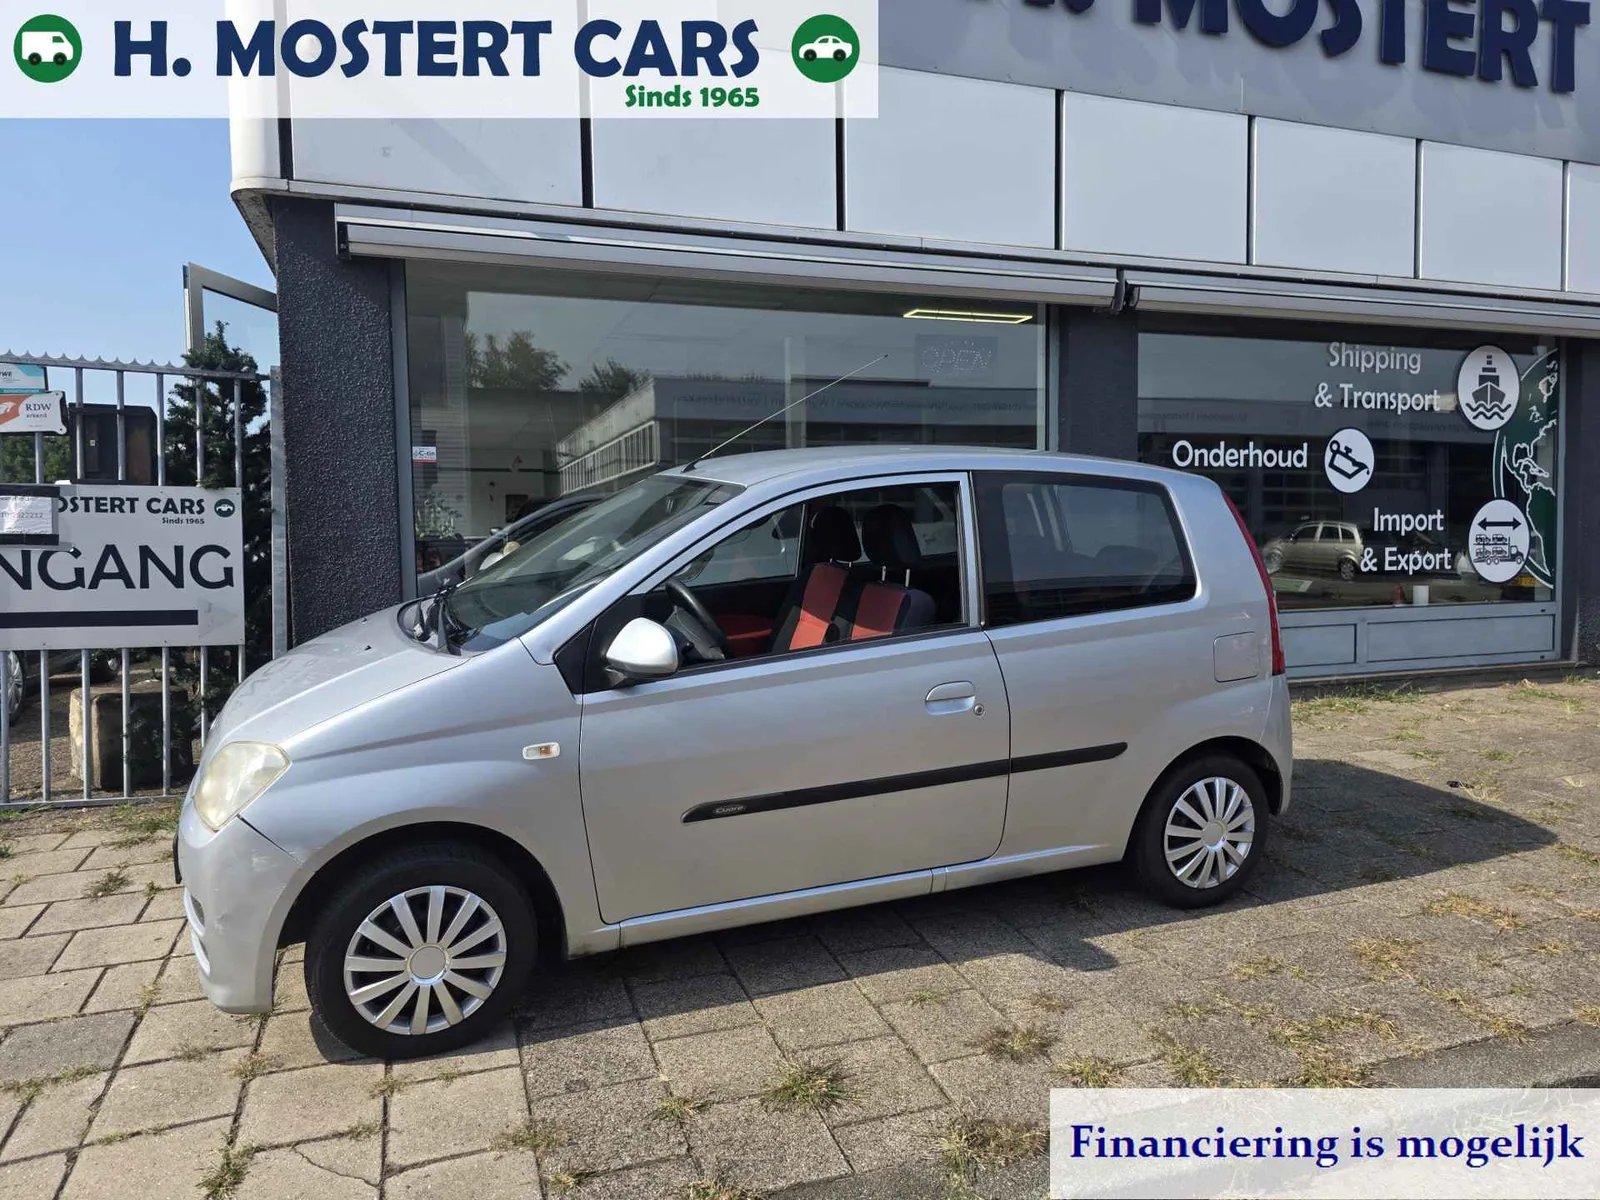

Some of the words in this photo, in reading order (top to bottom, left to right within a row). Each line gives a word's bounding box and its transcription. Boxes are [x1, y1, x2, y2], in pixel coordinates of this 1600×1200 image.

[1328, 341, 1421, 374] Shipping
[25, 403, 52, 411] RDW
[1314, 382, 1333, 408] &
[1339, 383, 1441, 415] Transport
[1172, 440, 1308, 468] Onderhoud
[58, 496, 139, 513] OSTERT
[146, 497, 205, 514] CARS
[185, 517, 205, 525] 1965
[1373, 507, 1444, 536] Import
[0, 543, 235, 590] NGANG
[1360, 547, 1378, 572] &
[1384, 547, 1452, 576] Export
